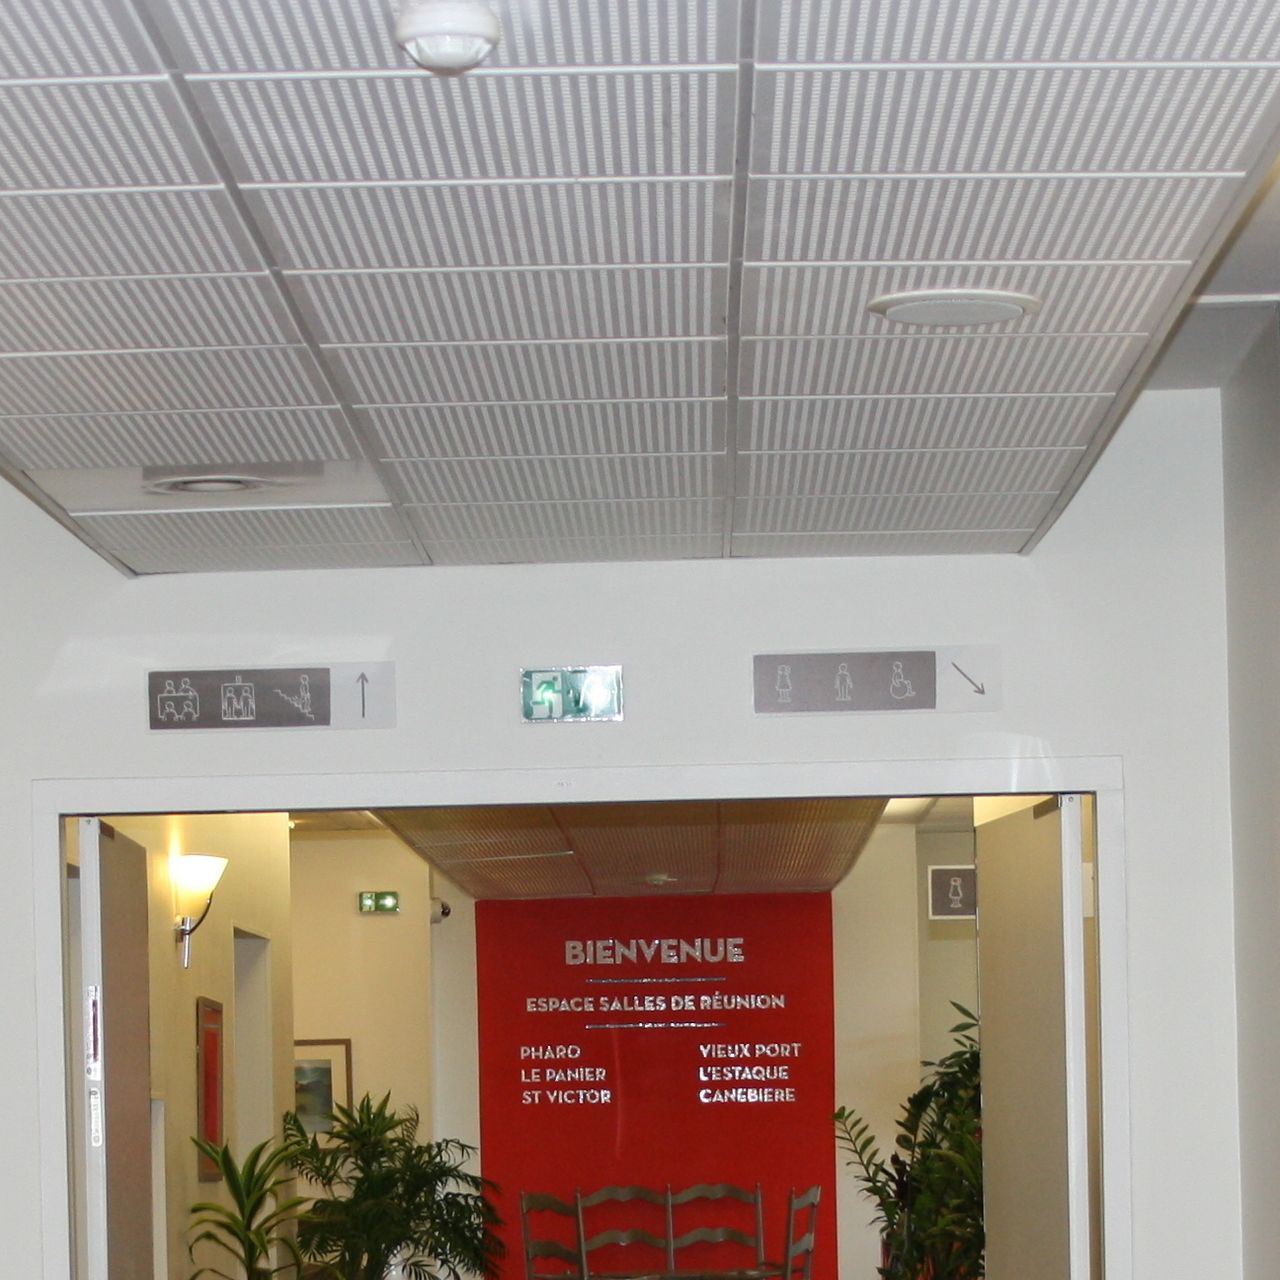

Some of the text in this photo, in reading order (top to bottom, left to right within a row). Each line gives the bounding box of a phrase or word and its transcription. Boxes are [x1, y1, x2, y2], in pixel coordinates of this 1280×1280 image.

[564, 937, 745, 966] BIENVENUE
[526, 990, 786, 1013] ESPACE SALLES DE RÉUNION
[520, 1044, 581, 1060] PHARO
[698, 1042, 802, 1058] VIEUX PORT
[521, 1067, 606, 1083] LE PANIER
[698, 1065, 790, 1081] L'ESTAQUE
[521, 1089, 612, 1105] ST VICTOR
